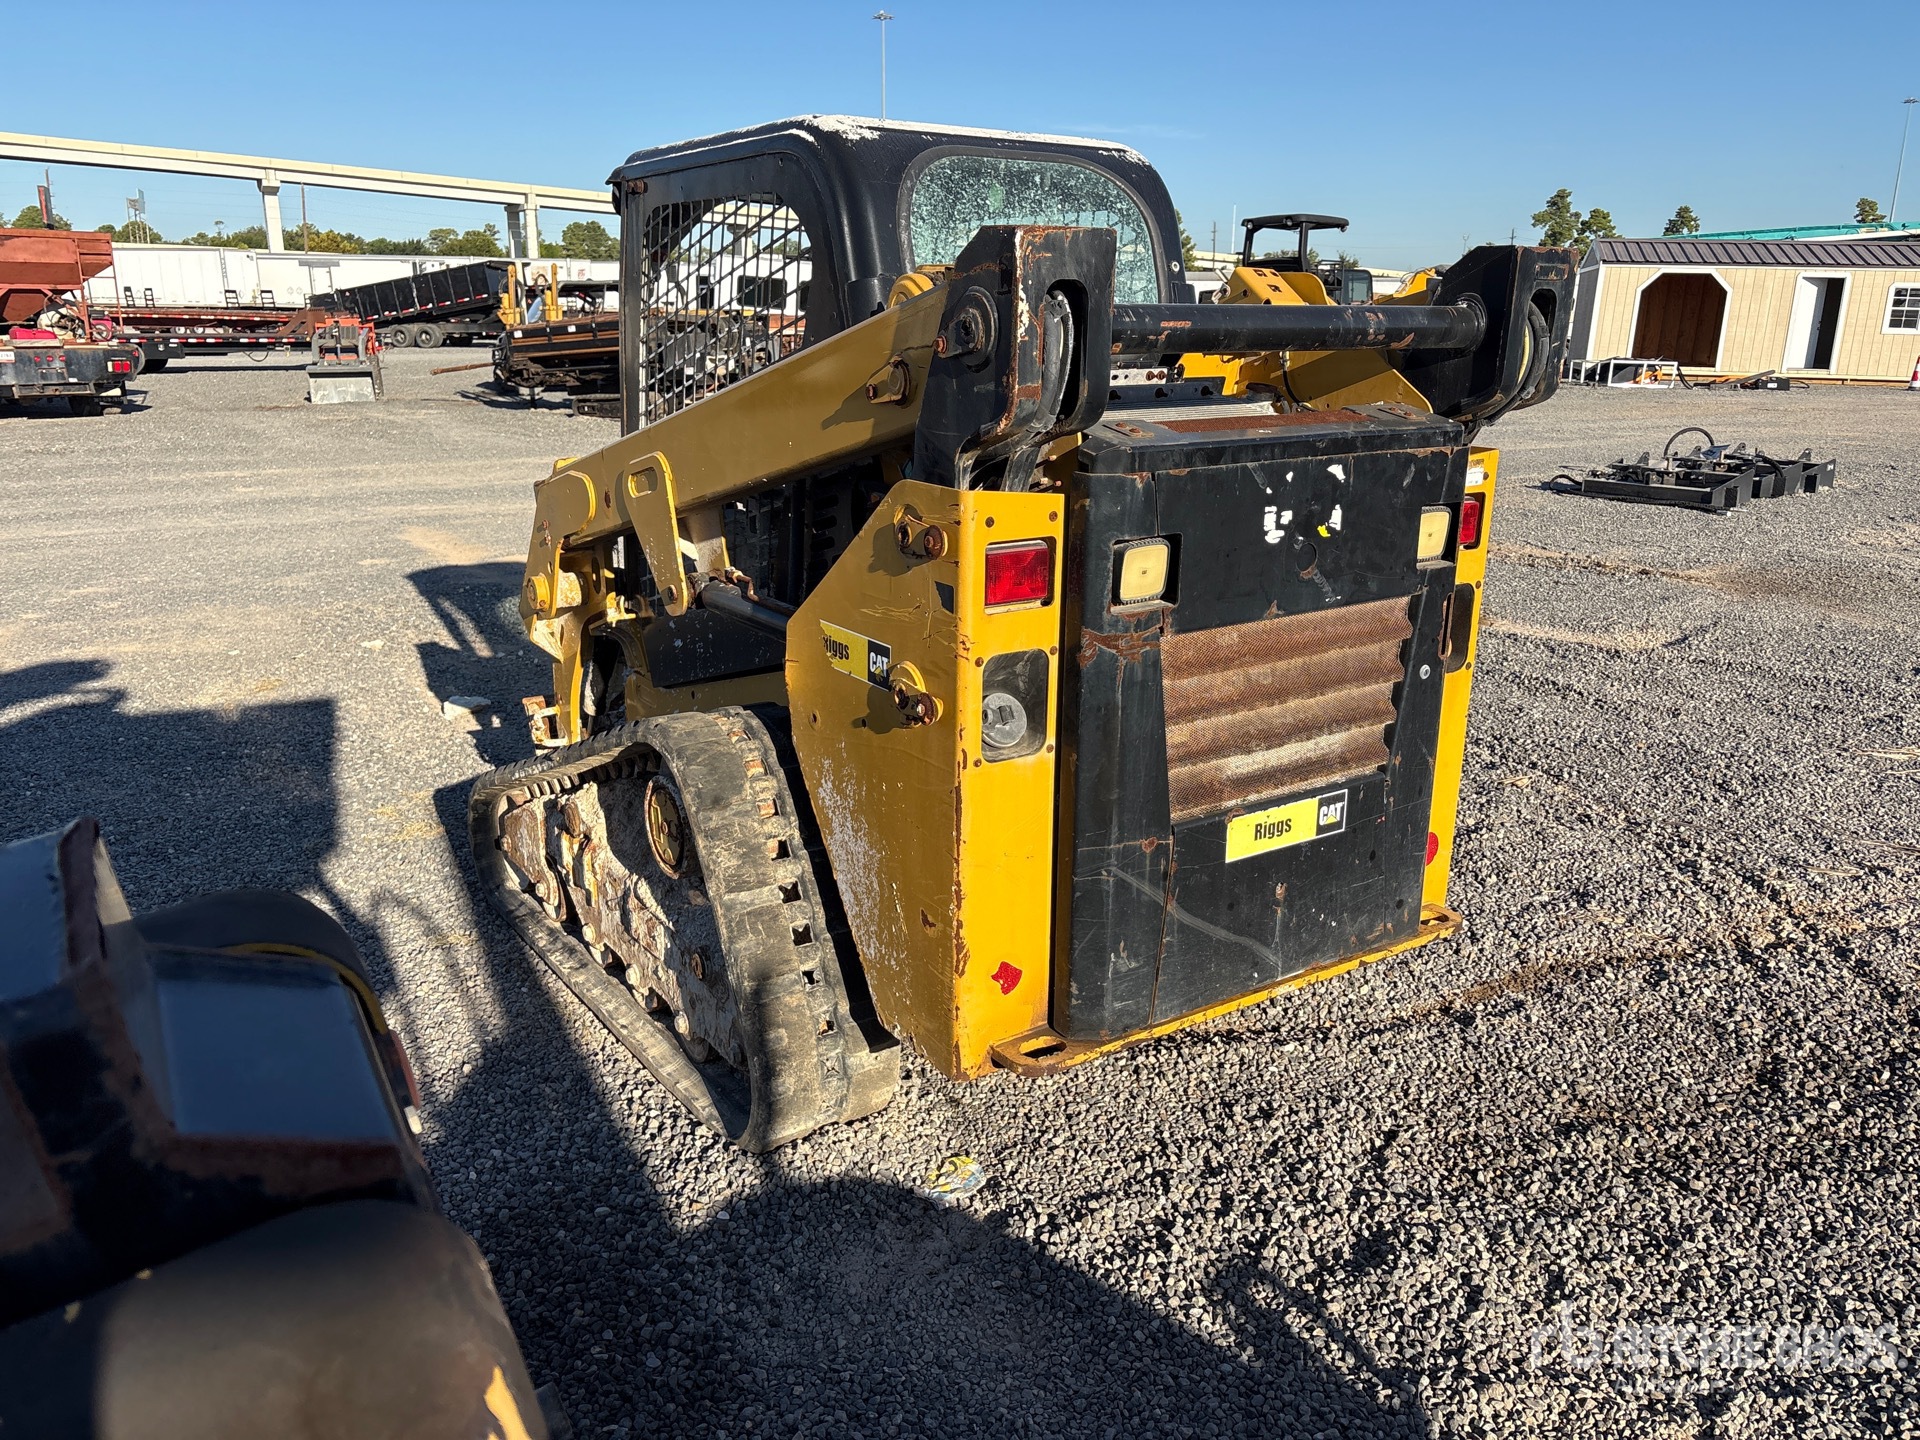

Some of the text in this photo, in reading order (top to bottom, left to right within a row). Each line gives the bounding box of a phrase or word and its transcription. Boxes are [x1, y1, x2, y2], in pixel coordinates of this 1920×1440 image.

[869, 651, 889, 678] CAT
[1253, 801, 1345, 841] Riggs CAT
